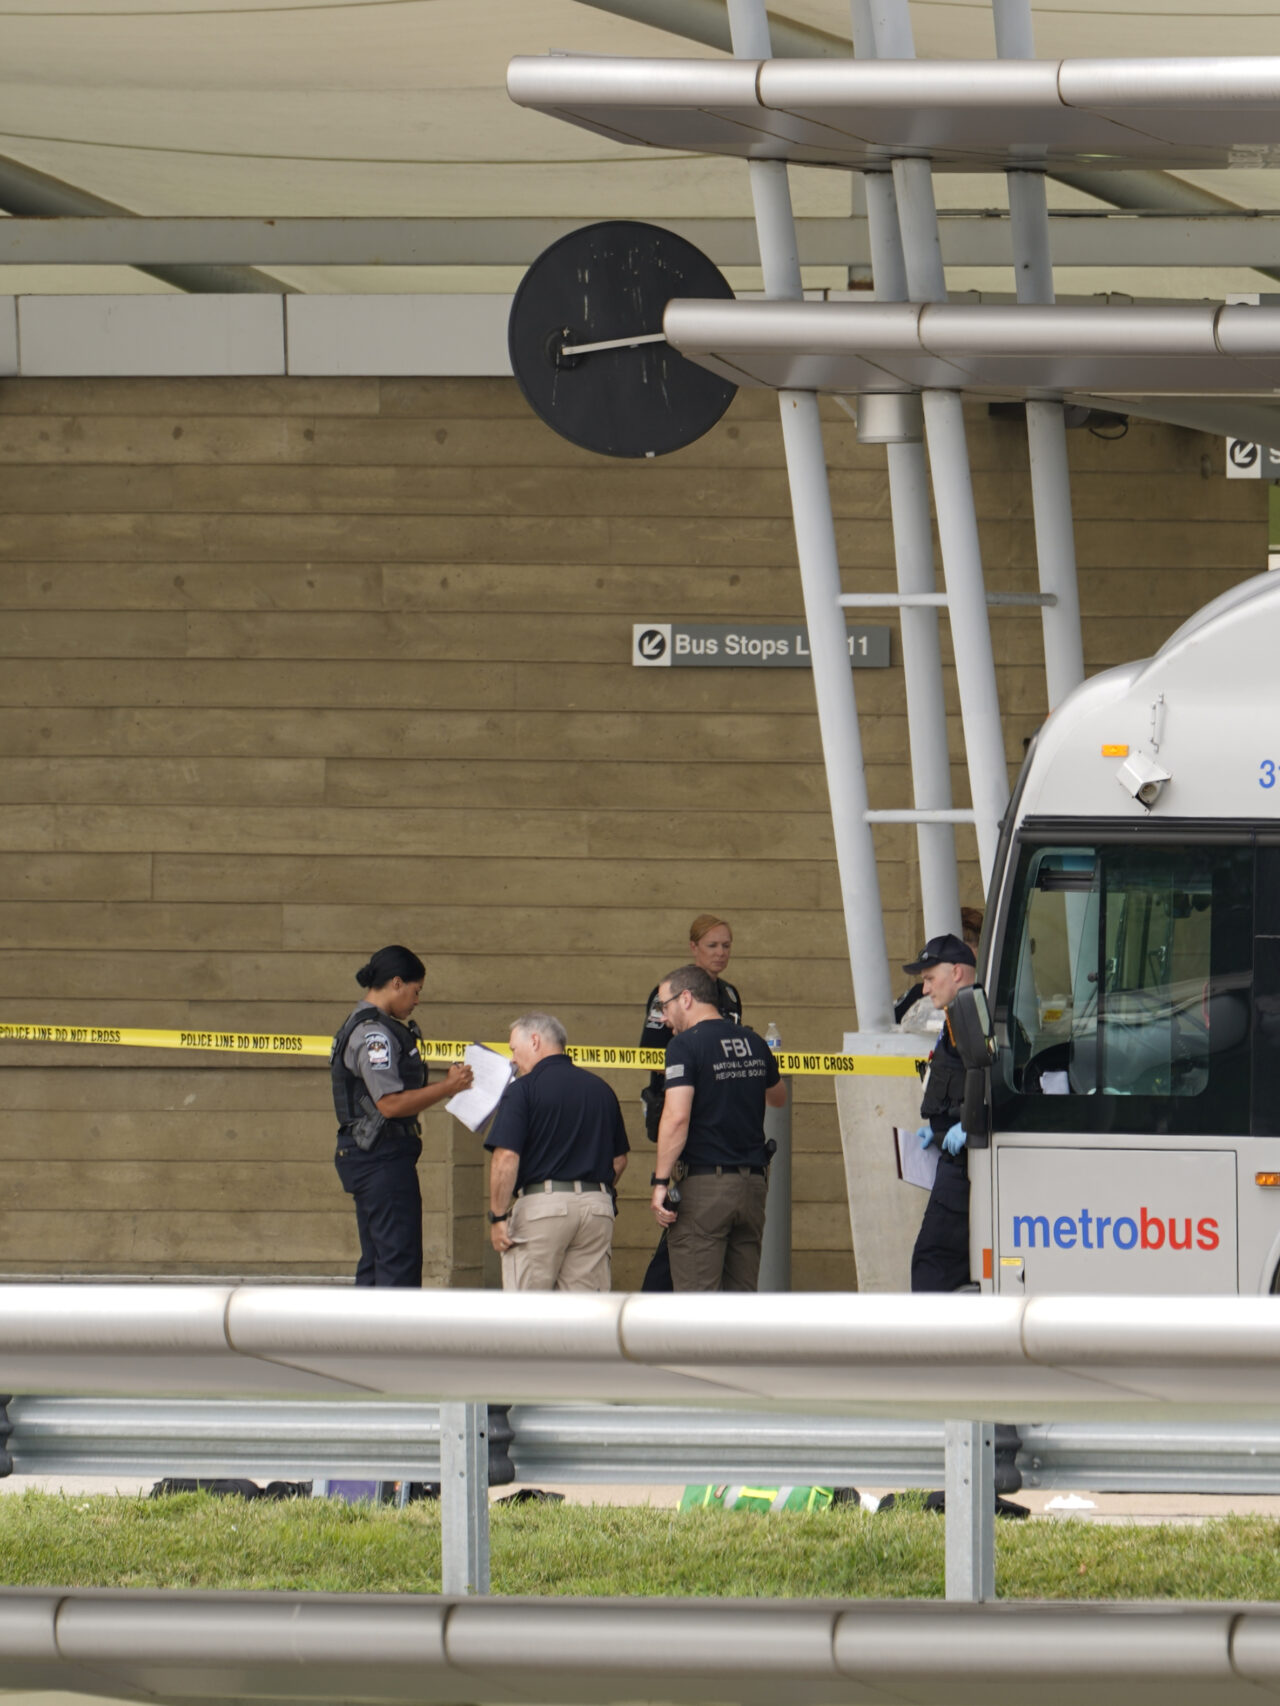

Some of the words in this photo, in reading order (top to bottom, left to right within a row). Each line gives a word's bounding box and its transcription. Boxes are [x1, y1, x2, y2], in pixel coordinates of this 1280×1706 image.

[675, 634, 718, 655] Bus
[725, 634, 789, 660] Stops
[0, 1026, 30, 1039] POLICE
[33, 1028, 52, 1040] LINE
[55, 1029, 68, 1041] DO
[70, 1030, 88, 1042] NOT
[91, 1030, 121, 1043] CROSS
[180, 1033, 212, 1048] POLICE
[215, 1035, 235, 1048] LINE
[237, 1036, 250, 1049] DO
[252, 1036, 270, 1049] NOT
[273, 1037, 303, 1051] CROSS
[420, 1043, 433, 1056] DO
[435, 1043, 453, 1057] NOT
[581, 1048, 601, 1062] LINE
[603, 1050, 617, 1063] DO
[619, 1050, 637, 1064] NOT
[639, 1051, 666, 1064] CROS
[720, 1037, 752, 1058] FBI
[788, 1055, 801, 1069] DO
[803, 1056, 821, 1070] NOT
[824, 1057, 854, 1071] CROSS
[1013, 1206, 1220, 1251] metrobus
